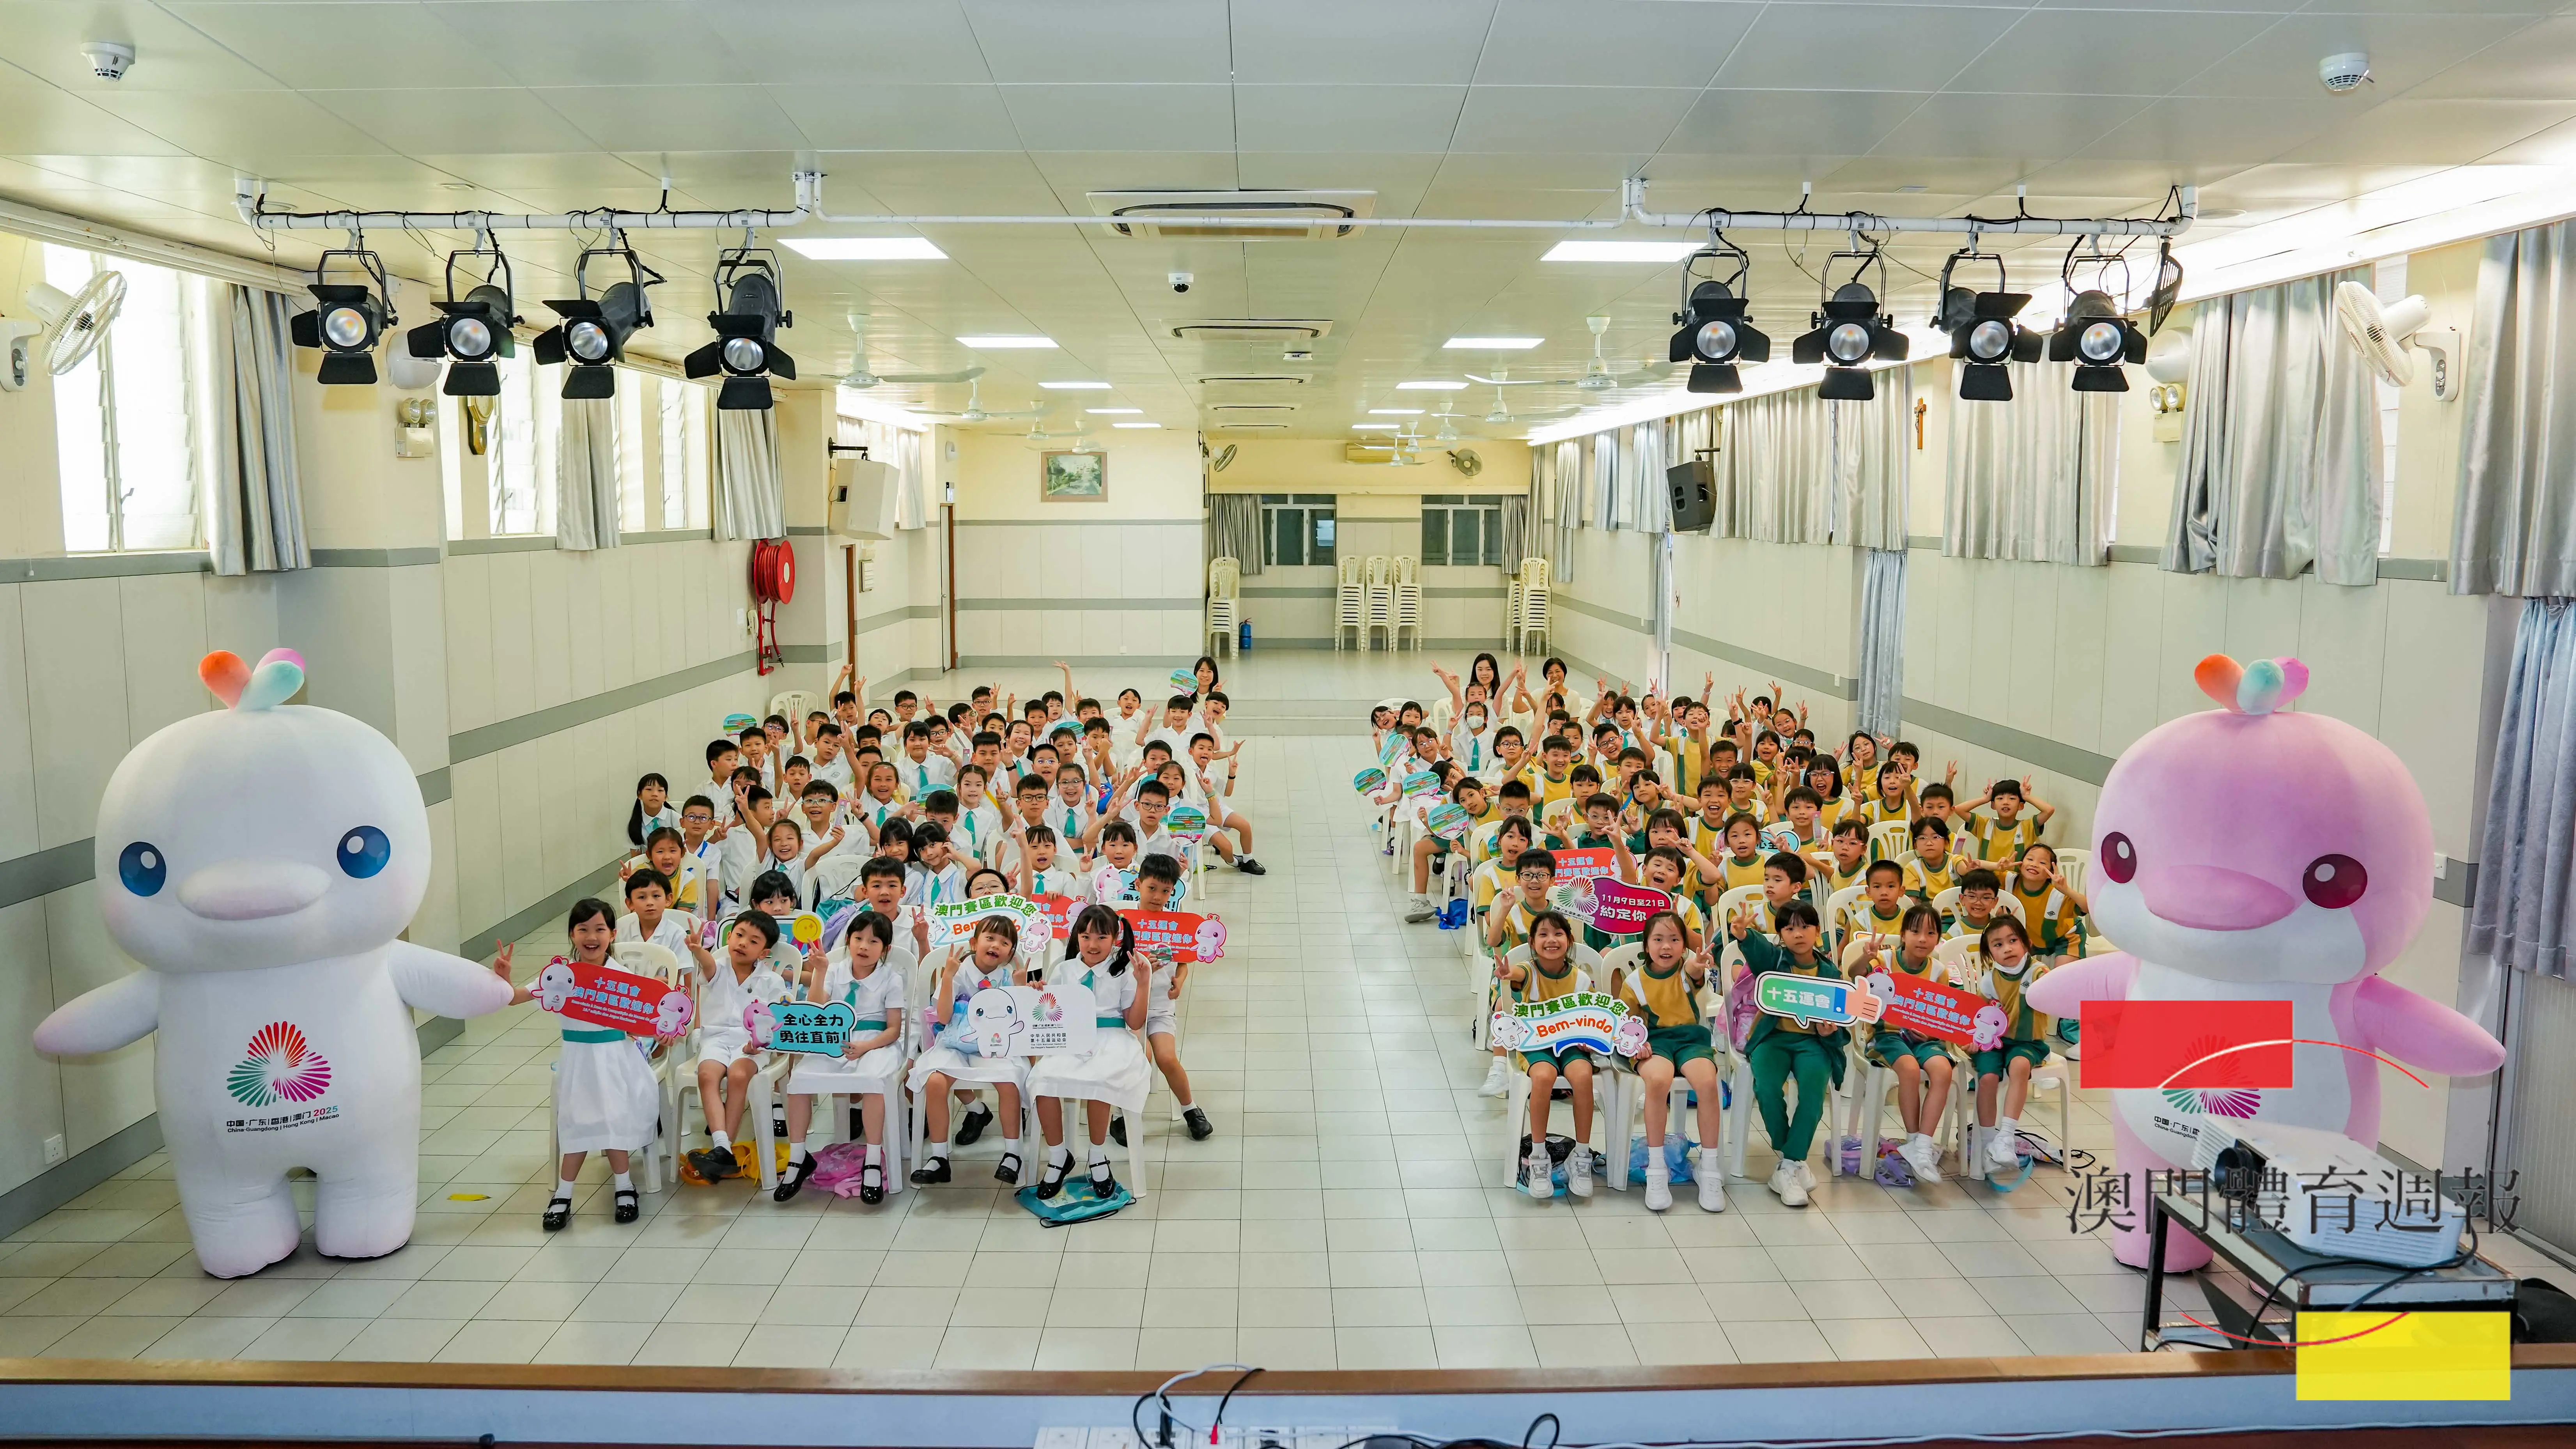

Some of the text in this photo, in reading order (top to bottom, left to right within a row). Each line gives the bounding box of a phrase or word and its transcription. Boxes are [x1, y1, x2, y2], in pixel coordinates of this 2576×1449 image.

[1558, 856, 1594, 866] 十五運會
[1555, 866, 1609, 877] 門賽區歡迎你
[935, 895, 1037, 917] 澳門賽區歡迎您
[1602, 894, 1665, 907] 11月9日至21日
[1600, 905, 1647, 922] 約定你
[1137, 919, 1178, 931] 十五運會
[1132, 930, 1192, 944] 門賽區歡迎你
[594, 977, 641, 997] 十五運會
[573, 986, 655, 1015] 澳門賽區歡迎你
[1514, 993, 1627, 1017] 澳門賽區歡迎您
[1767, 987, 1830, 1009] 十五運會
[1913, 987, 1958, 1009] 十五運會
[1893, 994, 1971, 1026] 澳門賽區歡迎你
[783, 1013, 843, 1027] 全心全力
[1536, 1015, 1612, 1038] Bem-vindo
[780, 1030, 846, 1044] 勇往直前!
[313, 1105, 338, 1117] 2025
